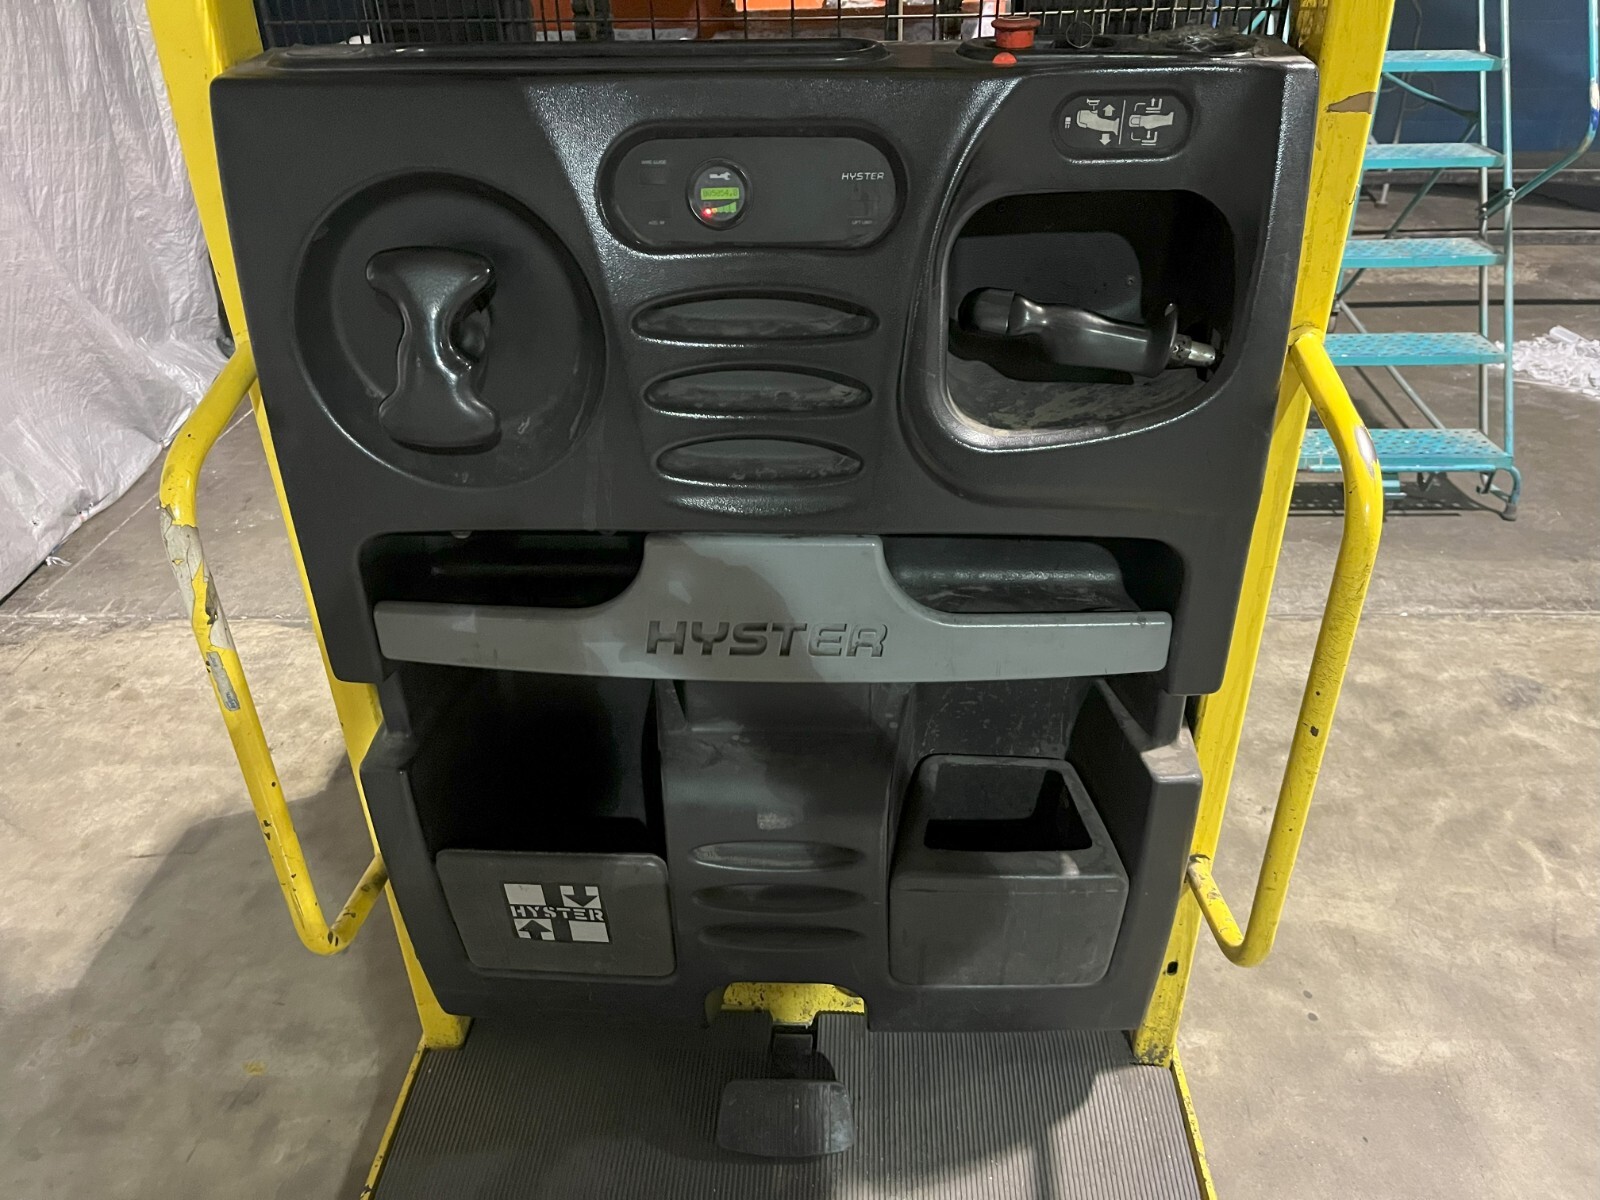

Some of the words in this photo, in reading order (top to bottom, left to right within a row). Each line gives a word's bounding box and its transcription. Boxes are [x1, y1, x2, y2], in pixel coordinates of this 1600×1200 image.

[841, 172, 885, 181] HYSTER
[646, 620, 888, 658] HYSTER
[510, 905, 605, 922] HYSTER
